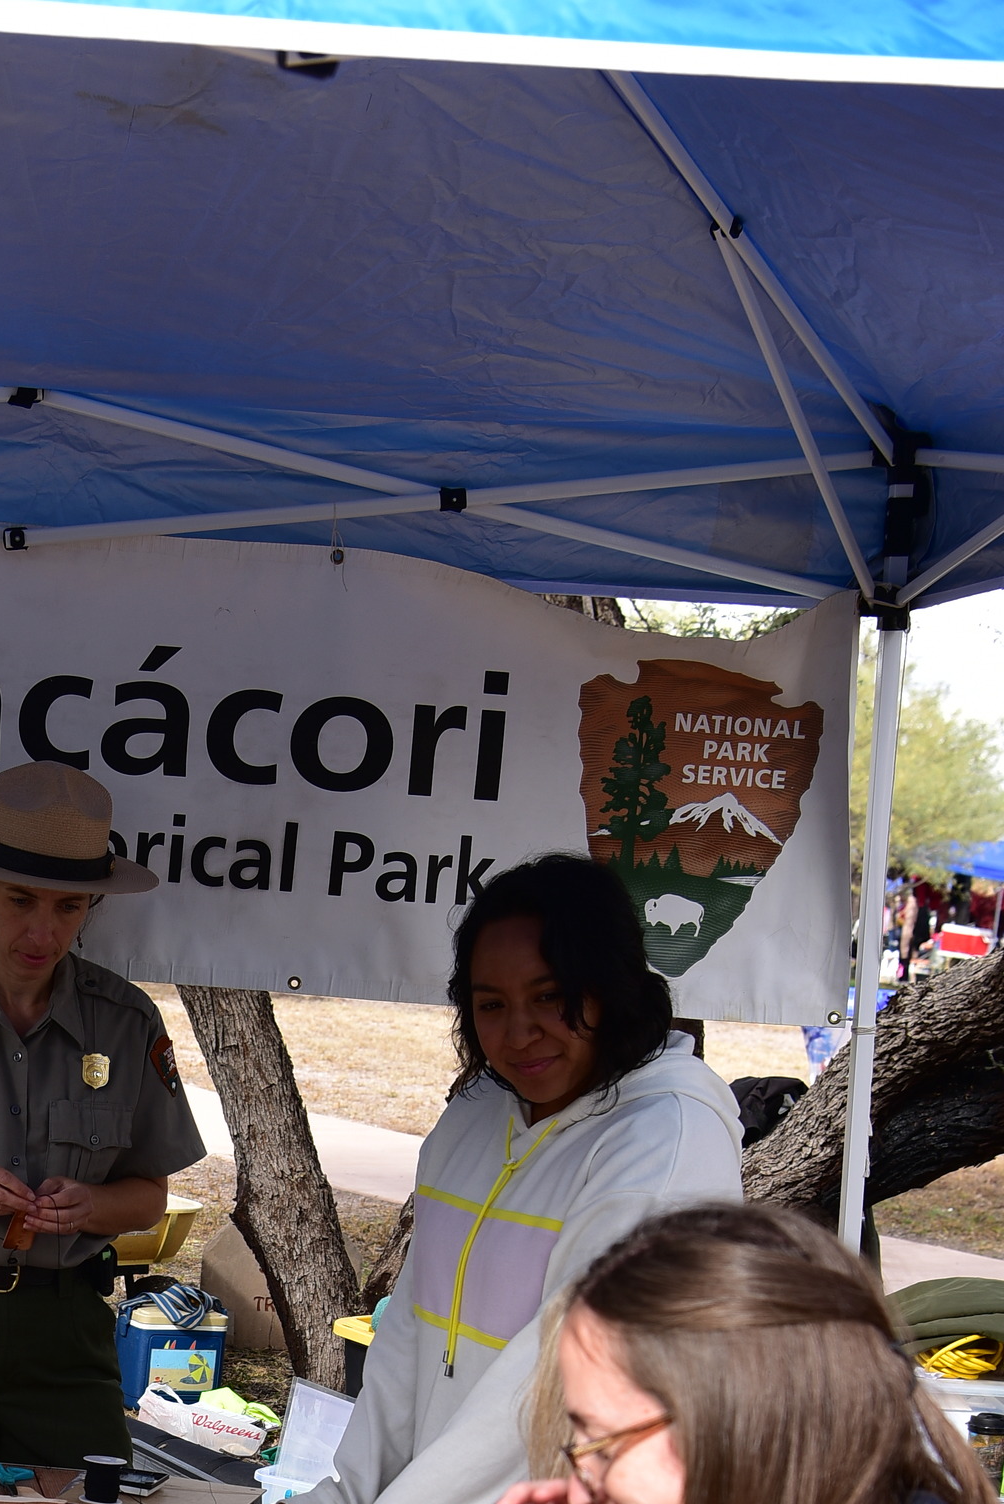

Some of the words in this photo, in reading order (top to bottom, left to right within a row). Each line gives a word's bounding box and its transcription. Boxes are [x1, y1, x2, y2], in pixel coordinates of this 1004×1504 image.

[674, 712, 806, 740] NATIONAL
[702, 741, 771, 764] PARK
[681, 764, 787, 790] SERVICE
[327, 830, 496, 906] Park
[191, 1412, 261, 1441] Walgreens
